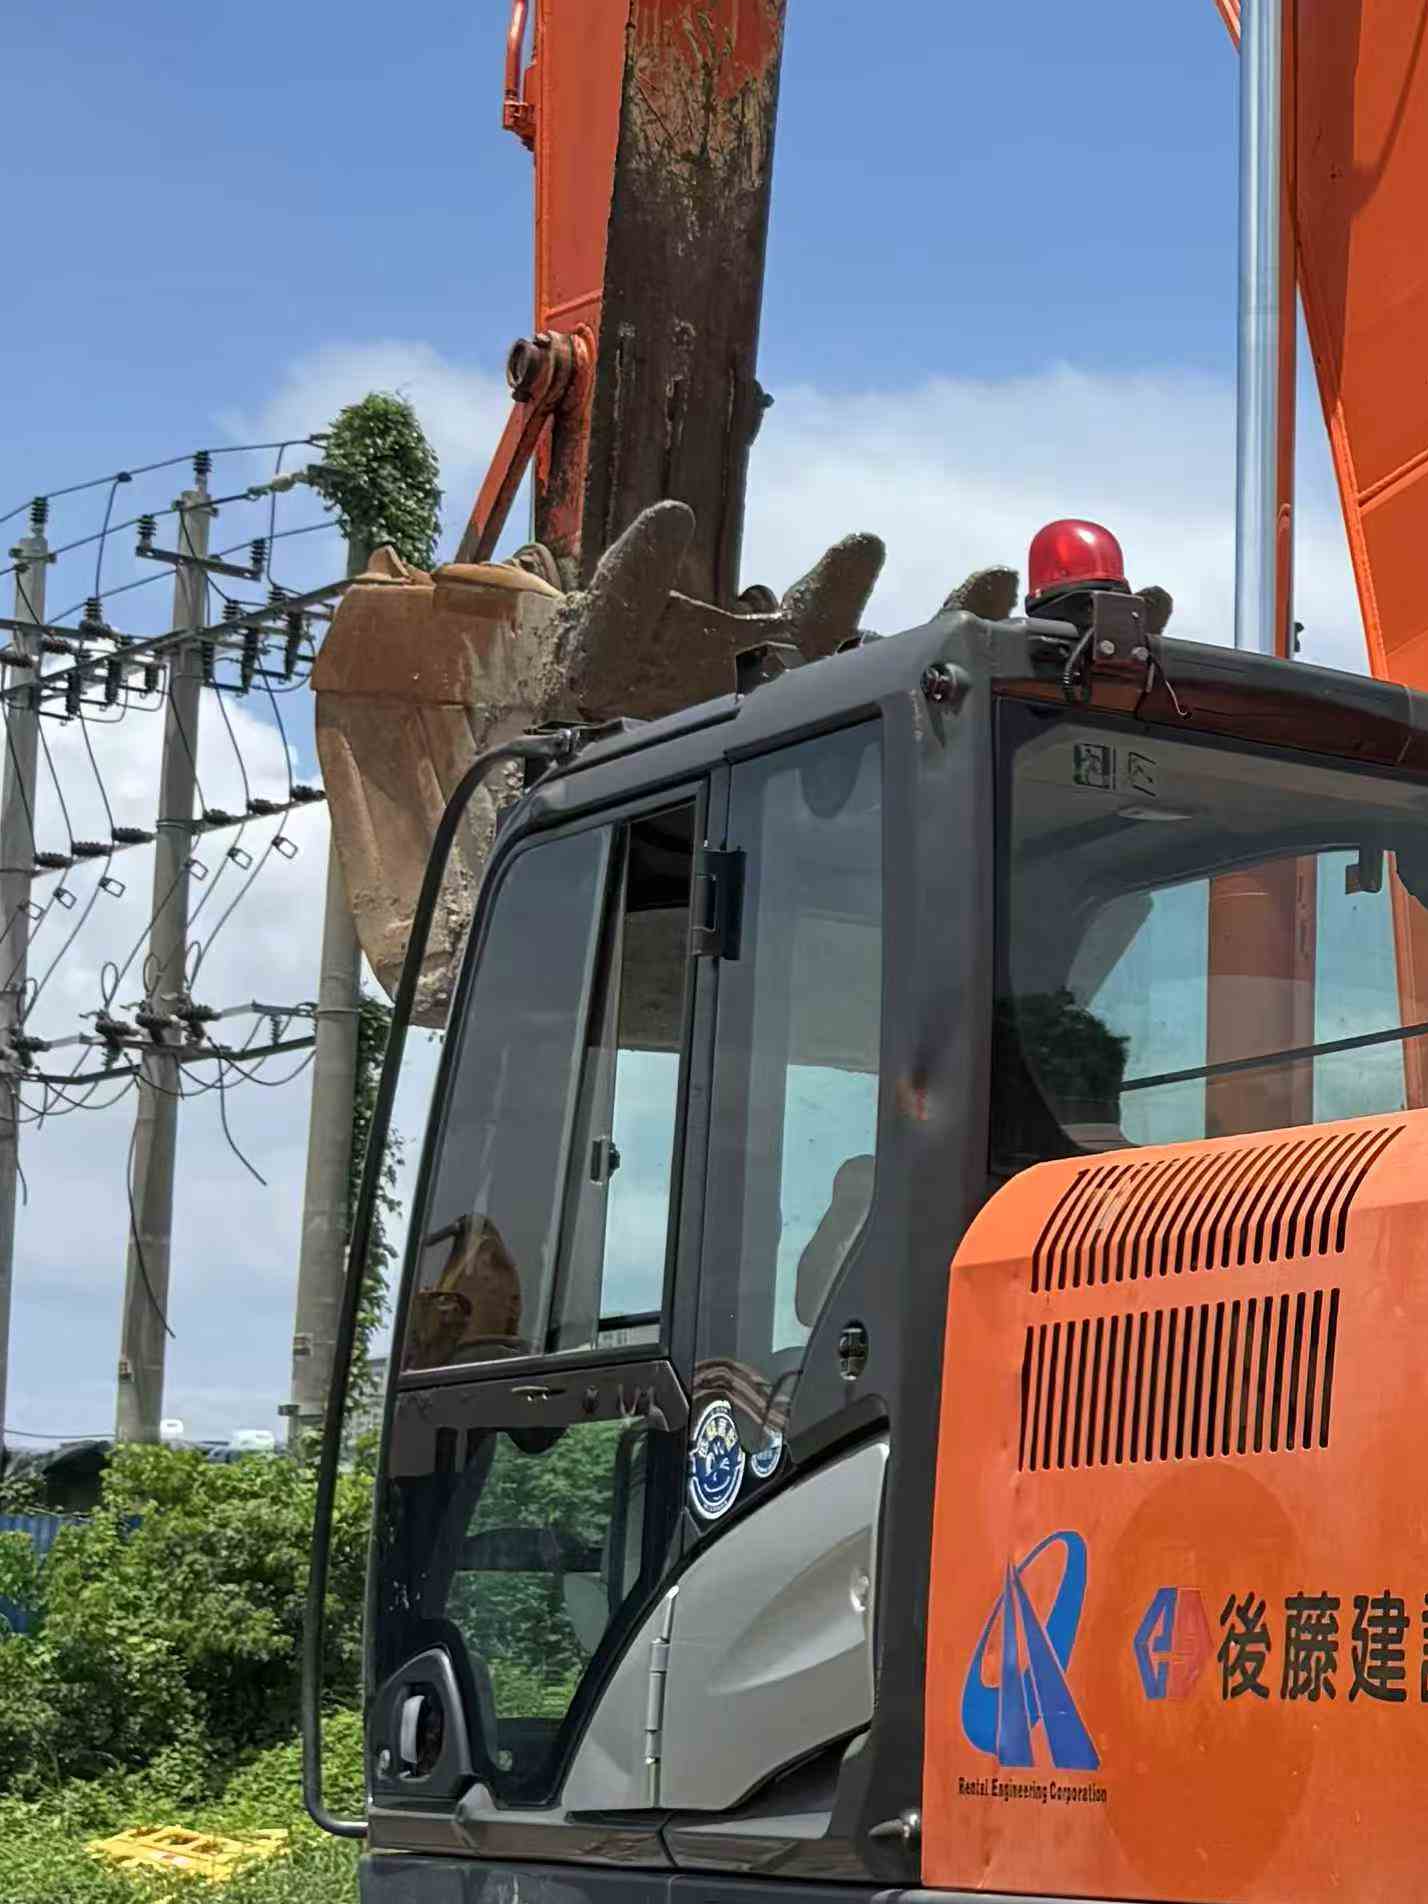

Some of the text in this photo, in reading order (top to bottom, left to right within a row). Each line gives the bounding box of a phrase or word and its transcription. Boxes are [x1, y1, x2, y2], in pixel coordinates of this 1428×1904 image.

[958, 1777, 1108, 1804] Rental Engineering Corporation
